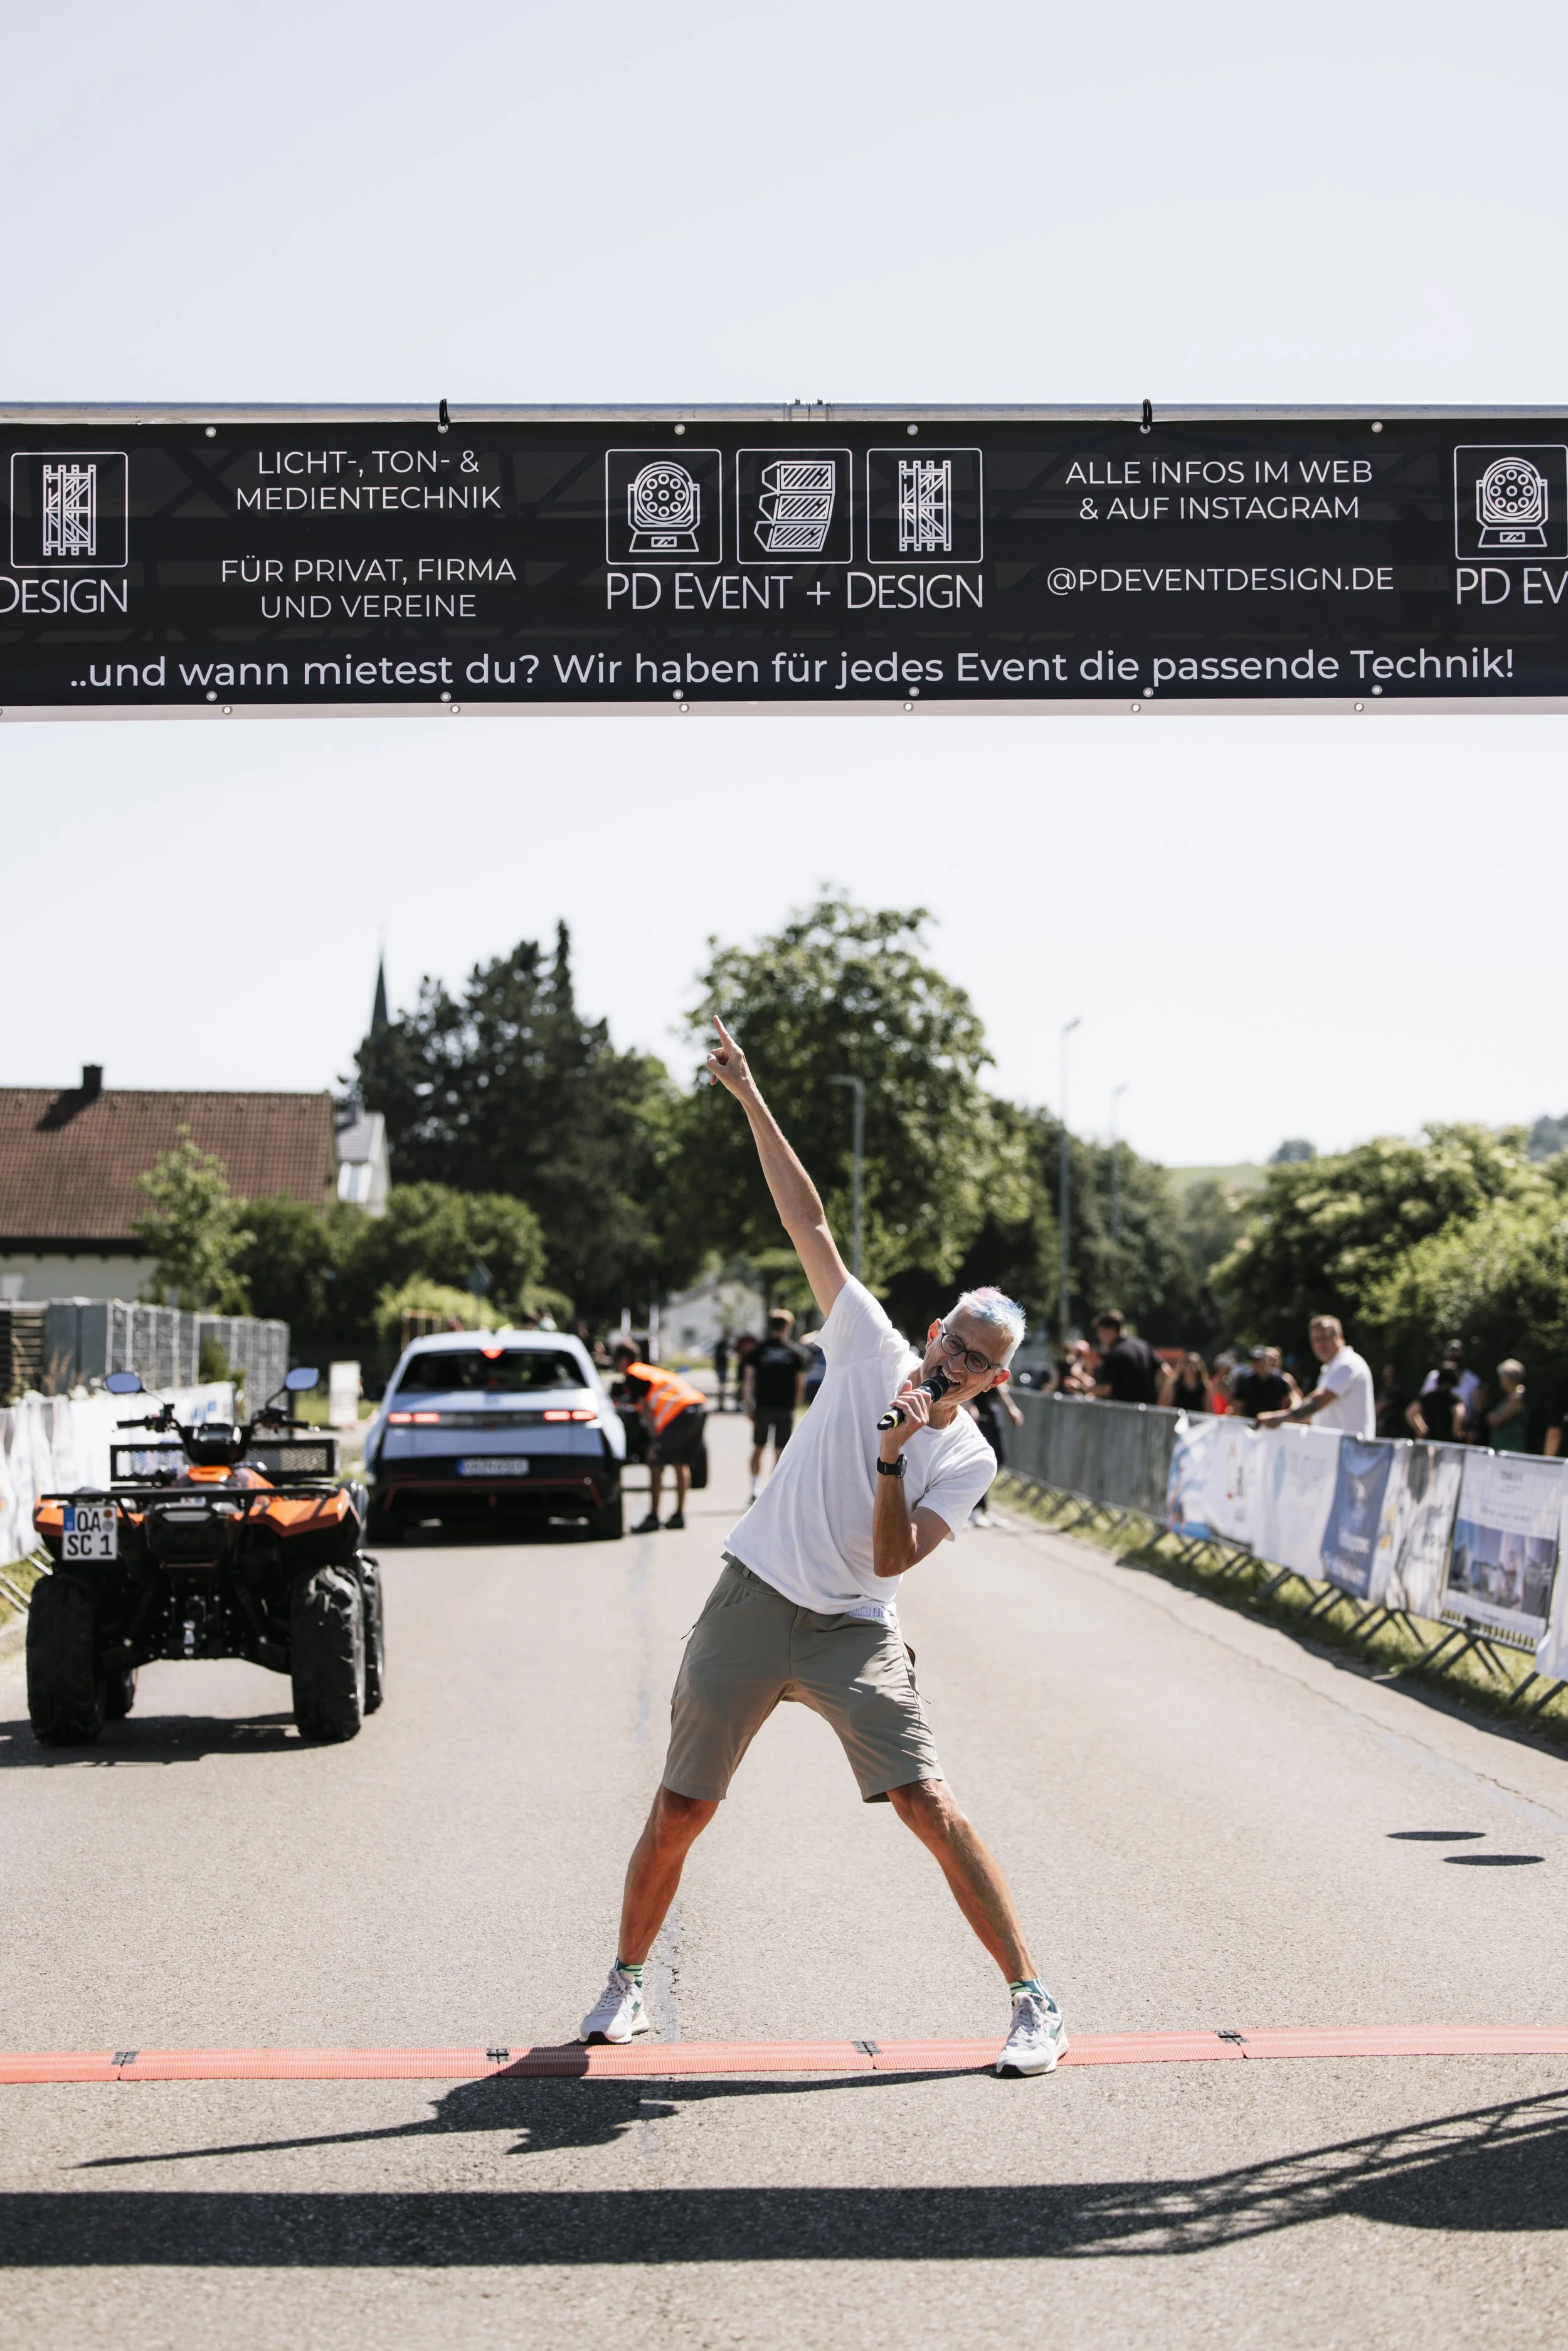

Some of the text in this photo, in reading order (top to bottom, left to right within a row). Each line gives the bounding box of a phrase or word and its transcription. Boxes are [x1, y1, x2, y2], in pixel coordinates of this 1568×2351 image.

[258, 450, 479, 477] LICHT-, TON- &
[1065, 461, 1372, 484] ALLE INFOS IM WEB
[237, 486, 501, 510] MEDIENTECHNIK
[1079, 497, 1359, 520] & AUF INSTAGRAM
[222, 555, 517, 585] FÜR PRIVAT, FIRMA
[1047, 567, 1394, 596] @PDEVENTDESIGN.DE
[607, 571, 983, 610] PD EVENT + DESIGN
[1456, 568, 1510, 605] PD
[262, 595, 476, 618] UND VEREINE
[71, 647, 1513, 689] ..und wann mietest du? Wir haben für jedes Event die passende Technik!
[78, 1511, 100, 1532] OA
[67, 1534, 112, 1556] SC 1
